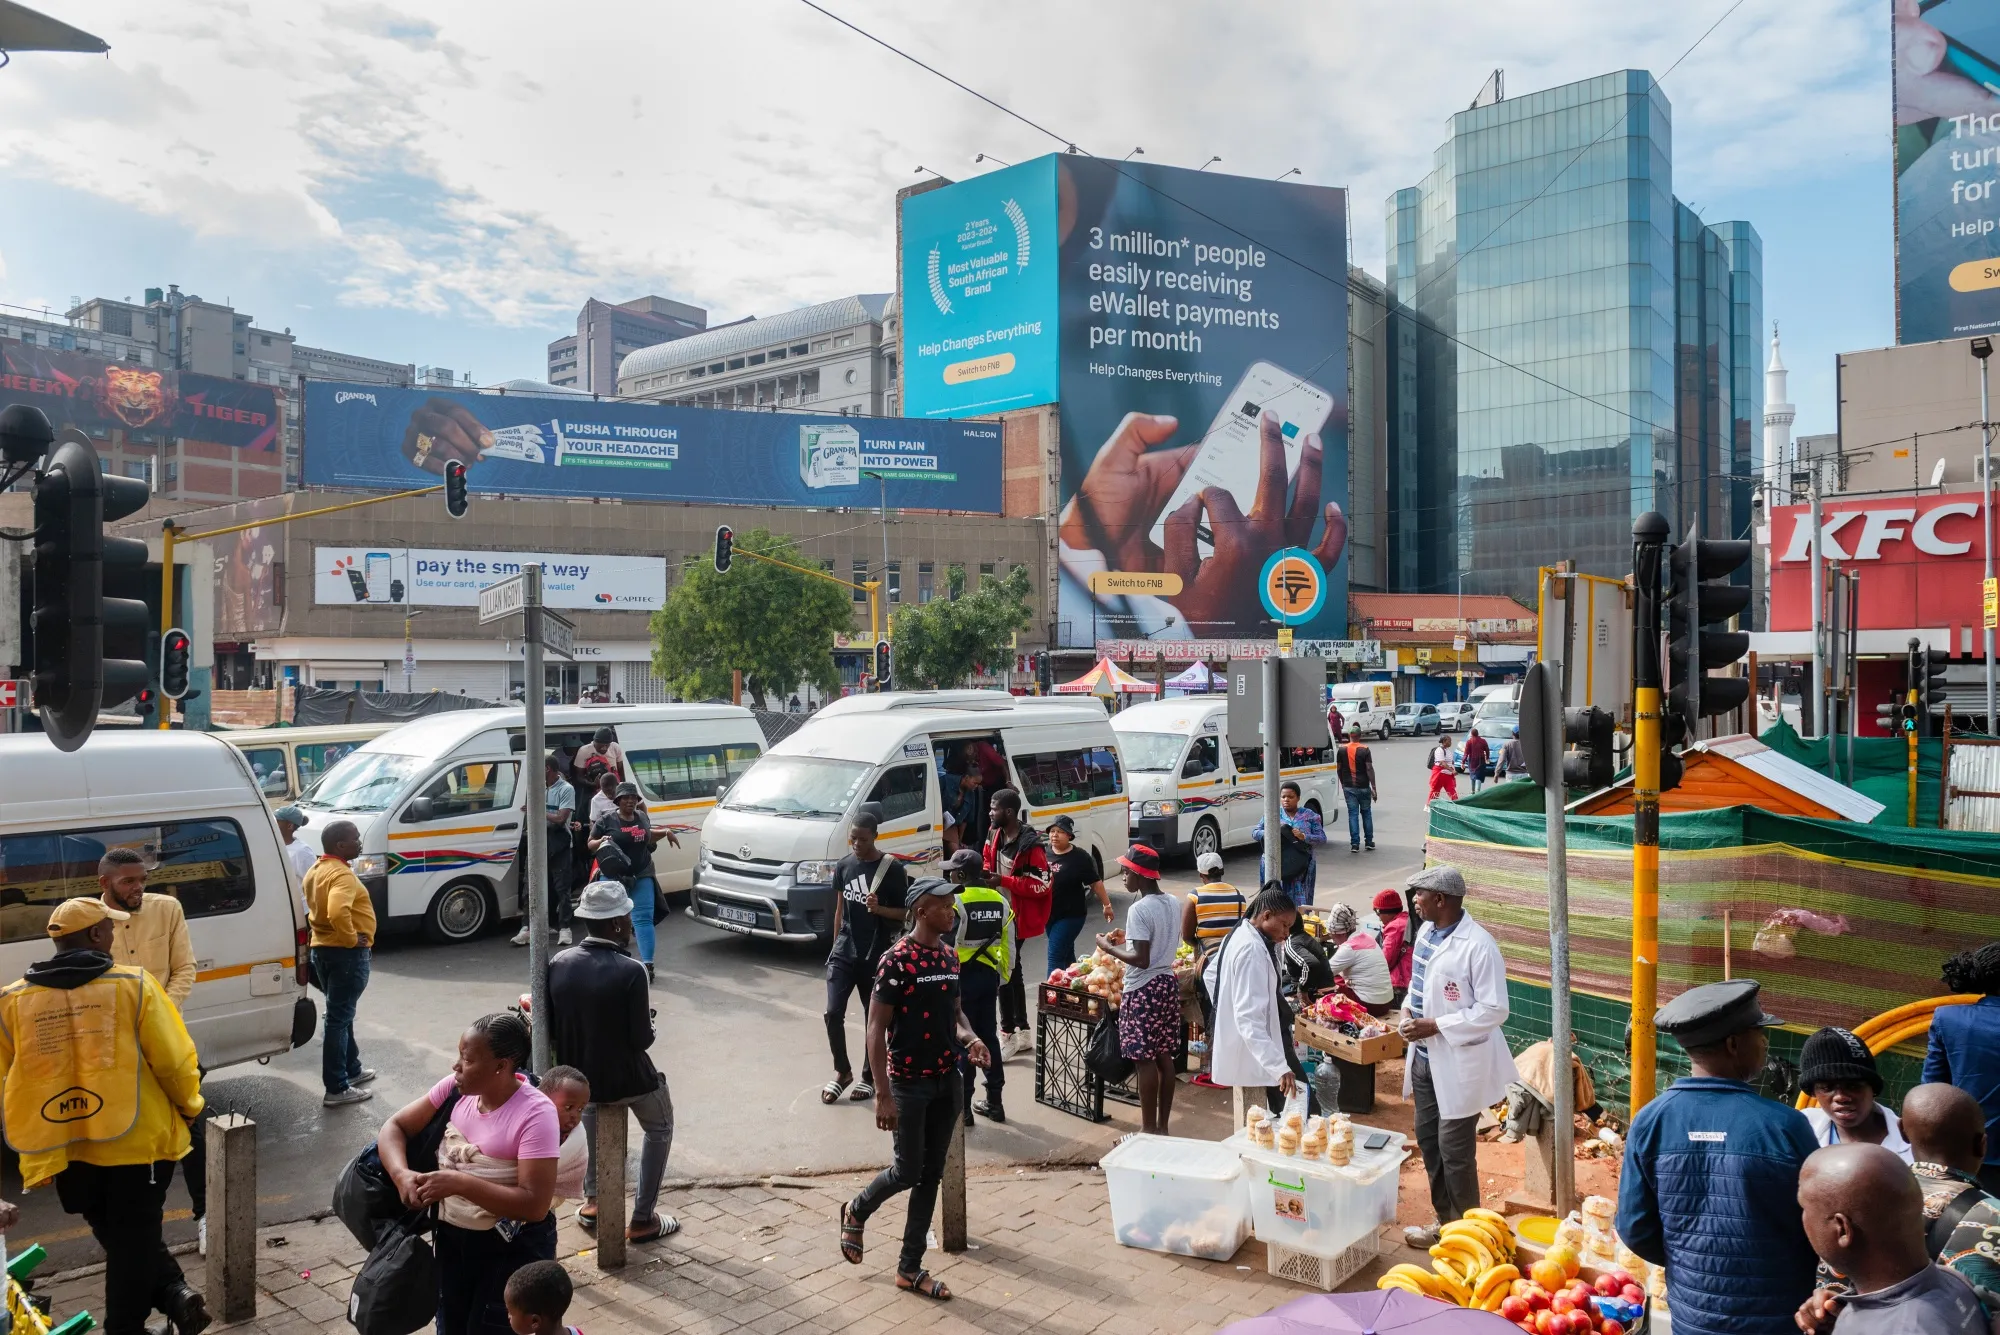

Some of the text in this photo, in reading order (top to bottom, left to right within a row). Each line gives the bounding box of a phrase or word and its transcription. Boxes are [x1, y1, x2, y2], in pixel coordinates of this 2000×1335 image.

[1950, 147, 2000, 172] tur
[1951, 179, 1996, 205] for
[965, 218, 990, 231] 2 Years
[1951, 219, 1995, 238] Help
[957, 224, 998, 243] 2023-2024
[1089, 227, 1104, 249] 3
[1194, 245, 1266, 271] people
[947, 251, 1008, 276] Most Valuable
[948, 265, 1008, 288] South African
[1089, 261, 1253, 302] easily receiving
[964, 281, 992, 298] Brand
[1089, 290, 1280, 330] eWallet payments
[918, 321, 1042, 357] Help Changes Everything
[1089, 325, 1202, 353] per month
[957, 364, 979, 377] Switch
[987, 361, 1000, 371] FNB
[1089, 362, 1222, 387] Help Changes Everything
[335, 391, 377, 407] GRAND-PA
[190, 400, 267, 427] TIGER
[565, 423, 678, 439] PUSHA THROUGH
[963, 430, 997, 438] HALEON
[567, 441, 676, 456] YOUR HEADACHE
[823, 446, 857, 459] GRAND-PA
[864, 440, 896, 449] TURN
[899, 441, 925, 450] PAIN
[863, 456, 935, 467] INTO POWER
[1779, 502, 1979, 562] KFC
[416, 558, 590, 580] pay the smt way
[416, 578, 434, 587] Use
[436, 580, 451, 588] our
[454, 579, 477, 589] card,
[548, 583, 575, 591] wallet
[1107, 578, 1163, 588] Switch to FNB
[615, 595, 654, 603] CAPITEC
[1120, 643, 1272, 658] SUPERIOR FRESH MEATS
[1332, 641, 1354, 649] FASHION
[59, 1097, 88, 1114] MTN
